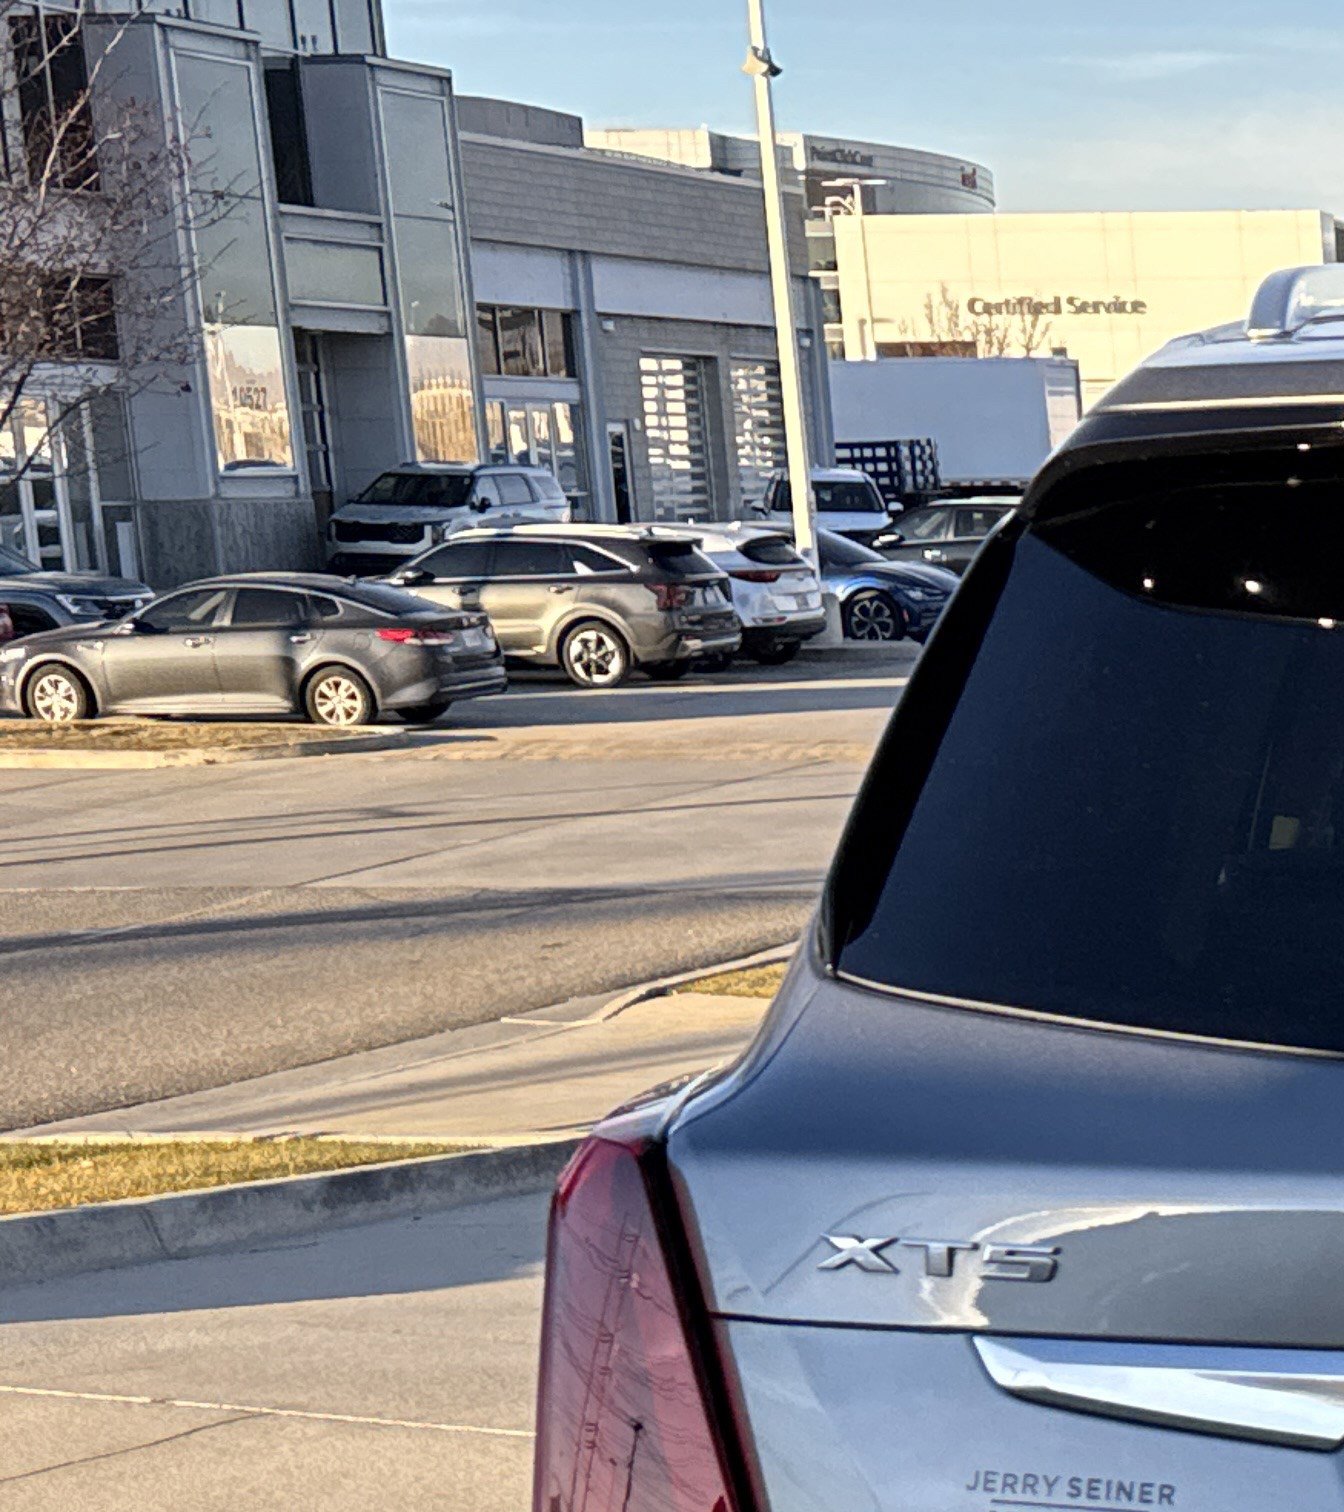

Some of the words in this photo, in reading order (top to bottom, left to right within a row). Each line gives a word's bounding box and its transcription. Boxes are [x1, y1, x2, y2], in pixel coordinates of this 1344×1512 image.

[967, 296, 1062, 315] Certified
[1066, 296, 1147, 315] Service
[967, 1470, 1061, 1496] JERRY
[1066, 1476, 1176, 1506] SEINER
